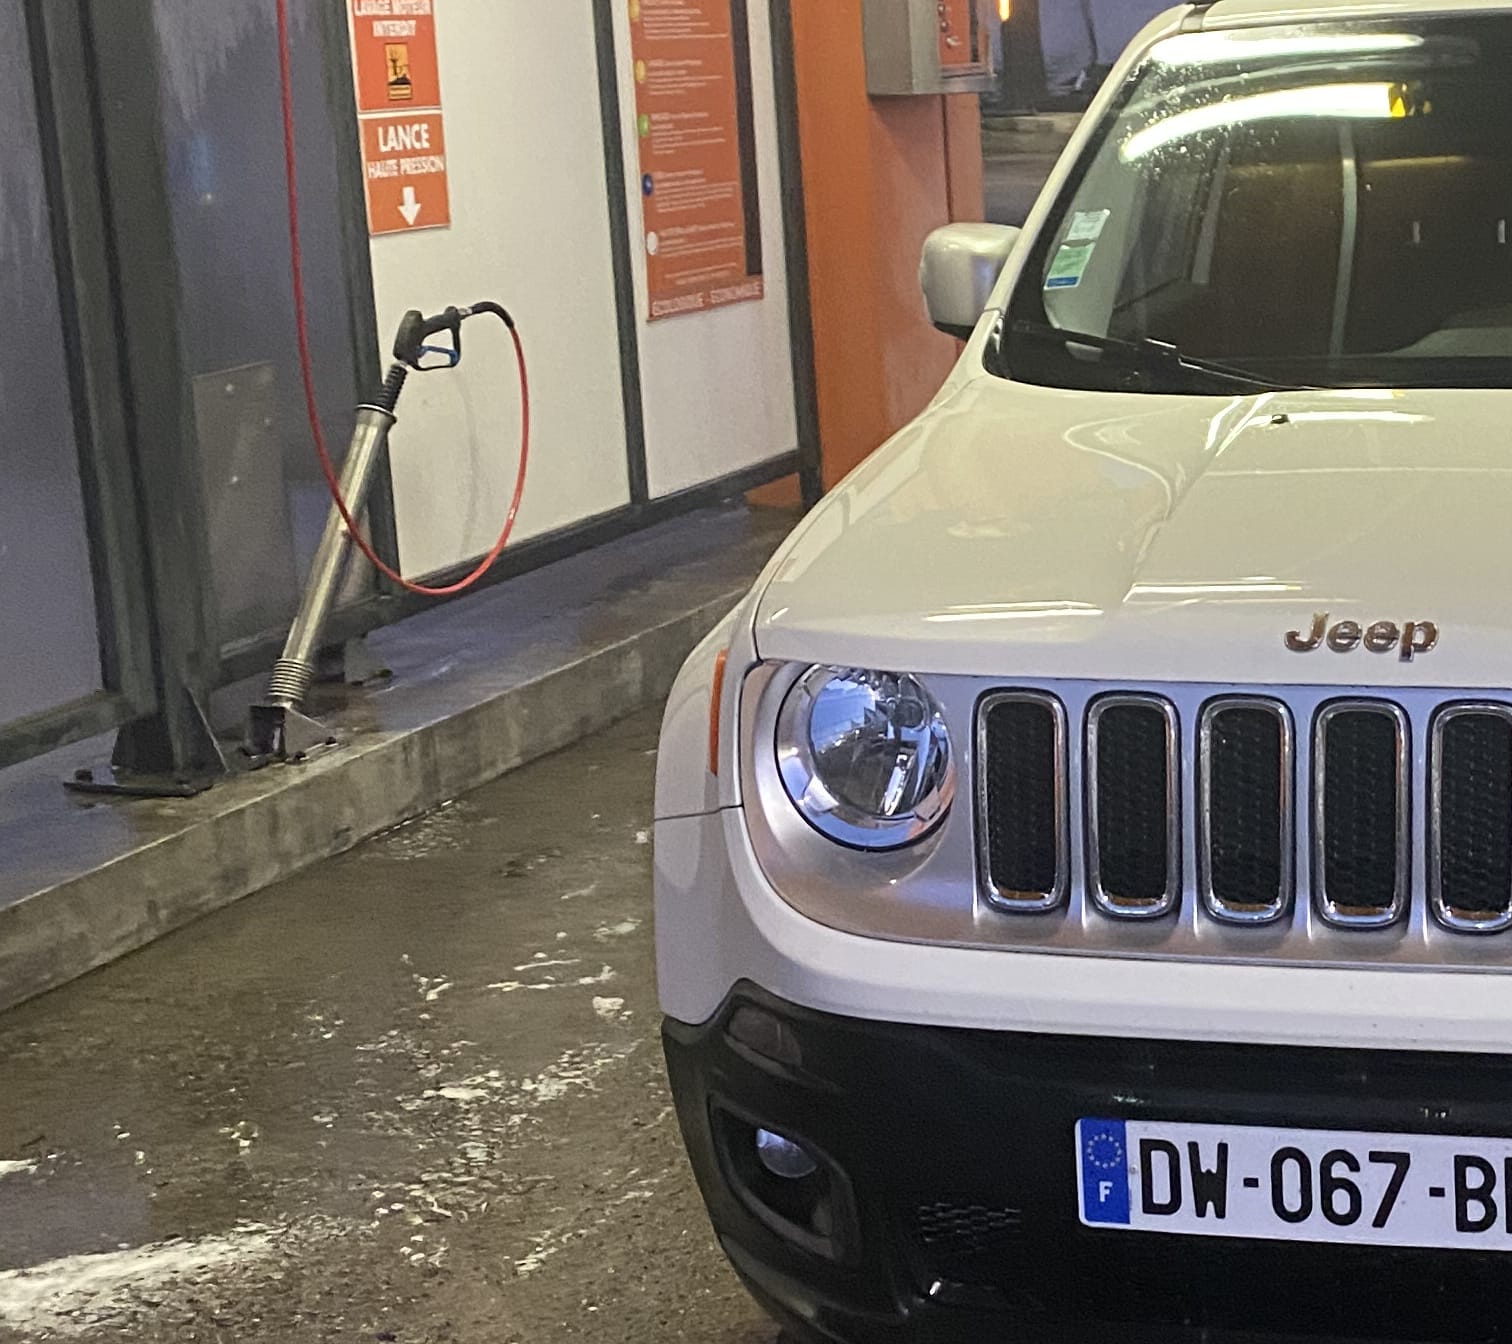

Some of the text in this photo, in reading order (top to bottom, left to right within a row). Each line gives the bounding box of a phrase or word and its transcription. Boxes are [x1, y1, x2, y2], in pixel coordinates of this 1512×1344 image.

[378, 123, 430, 152] LANCE
[1284, 612, 1439, 663] Jeep
[1099, 1181, 1113, 1202] F
